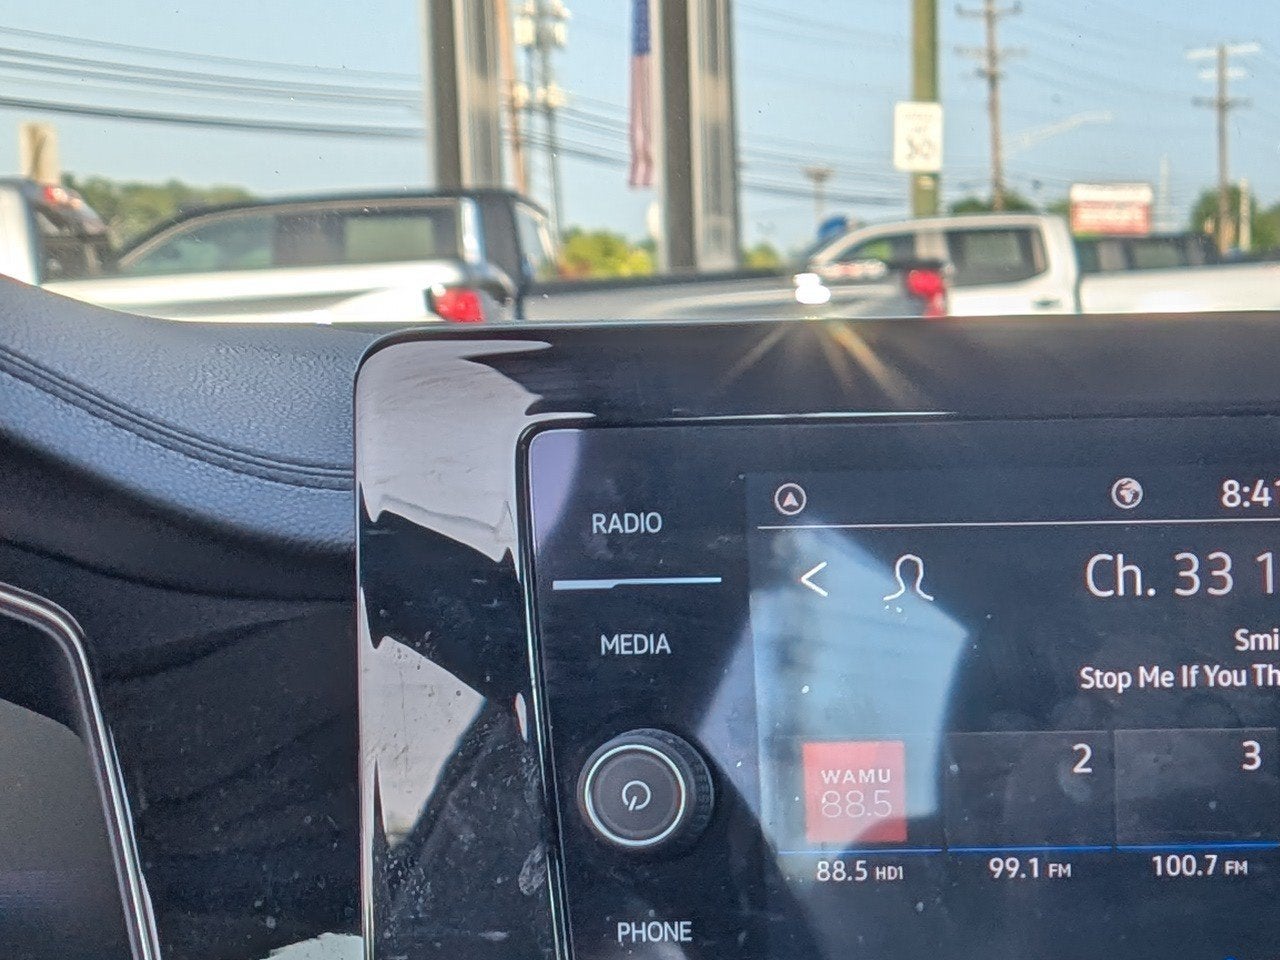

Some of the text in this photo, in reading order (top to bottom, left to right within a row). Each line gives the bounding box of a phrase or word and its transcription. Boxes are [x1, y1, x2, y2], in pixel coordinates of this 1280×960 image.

[592, 511, 663, 534] RADIO
[1086, 553, 1156, 597] Ch.
[1174, 551, 1234, 596] 33
[600, 633, 672, 656] MEDIA
[1080, 666, 1133, 694] Stop
[1138, 665, 1175, 688] Me
[1181, 664, 1199, 688] If
[1203, 664, 1247, 687] You
[1072, 743, 1093, 774] 2
[1242, 740, 1262, 771] 3
[820, 768, 891, 785] WAMU
[821, 789, 892, 818] 88.5
[816, 861, 868, 882] 88.5
[989, 857, 1072, 879] 99.1 FM
[1152, 854, 1248, 877] 100.7 FM
[617, 920, 693, 943] PHONE
